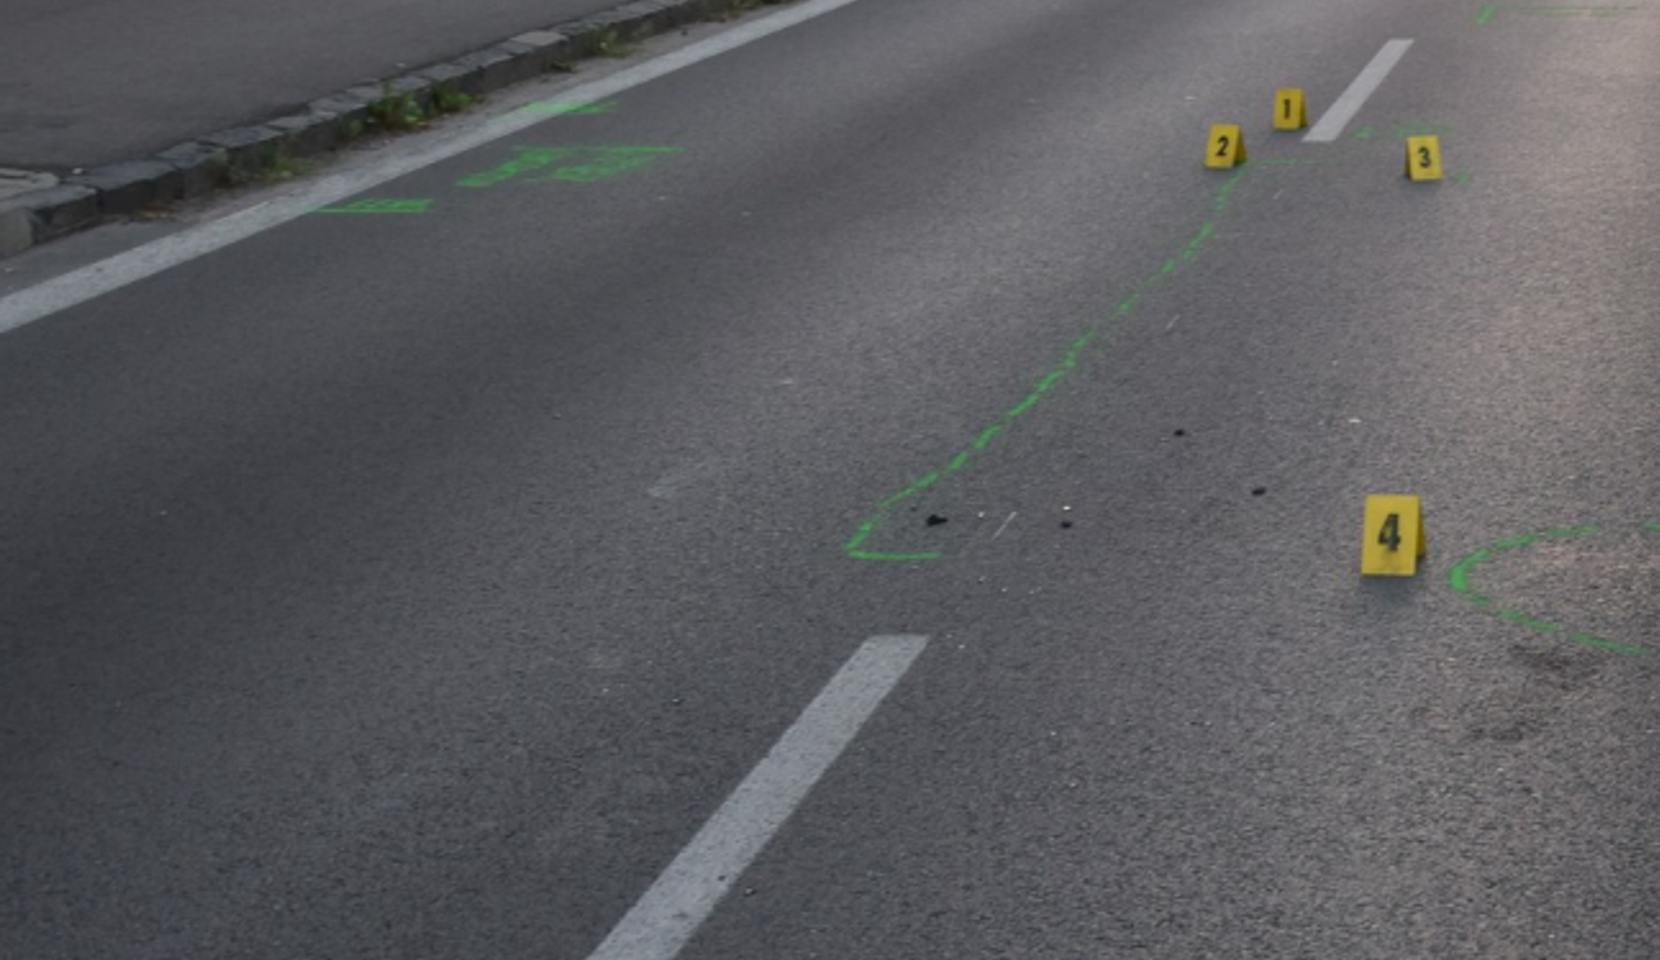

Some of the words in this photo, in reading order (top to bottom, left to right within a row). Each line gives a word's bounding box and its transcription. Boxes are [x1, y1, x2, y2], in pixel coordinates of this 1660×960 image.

[1283, 99, 1291, 120] 1
[1215, 136, 1230, 157] 2
[1418, 147, 1431, 168] 3
[1378, 513, 1402, 552] 4
